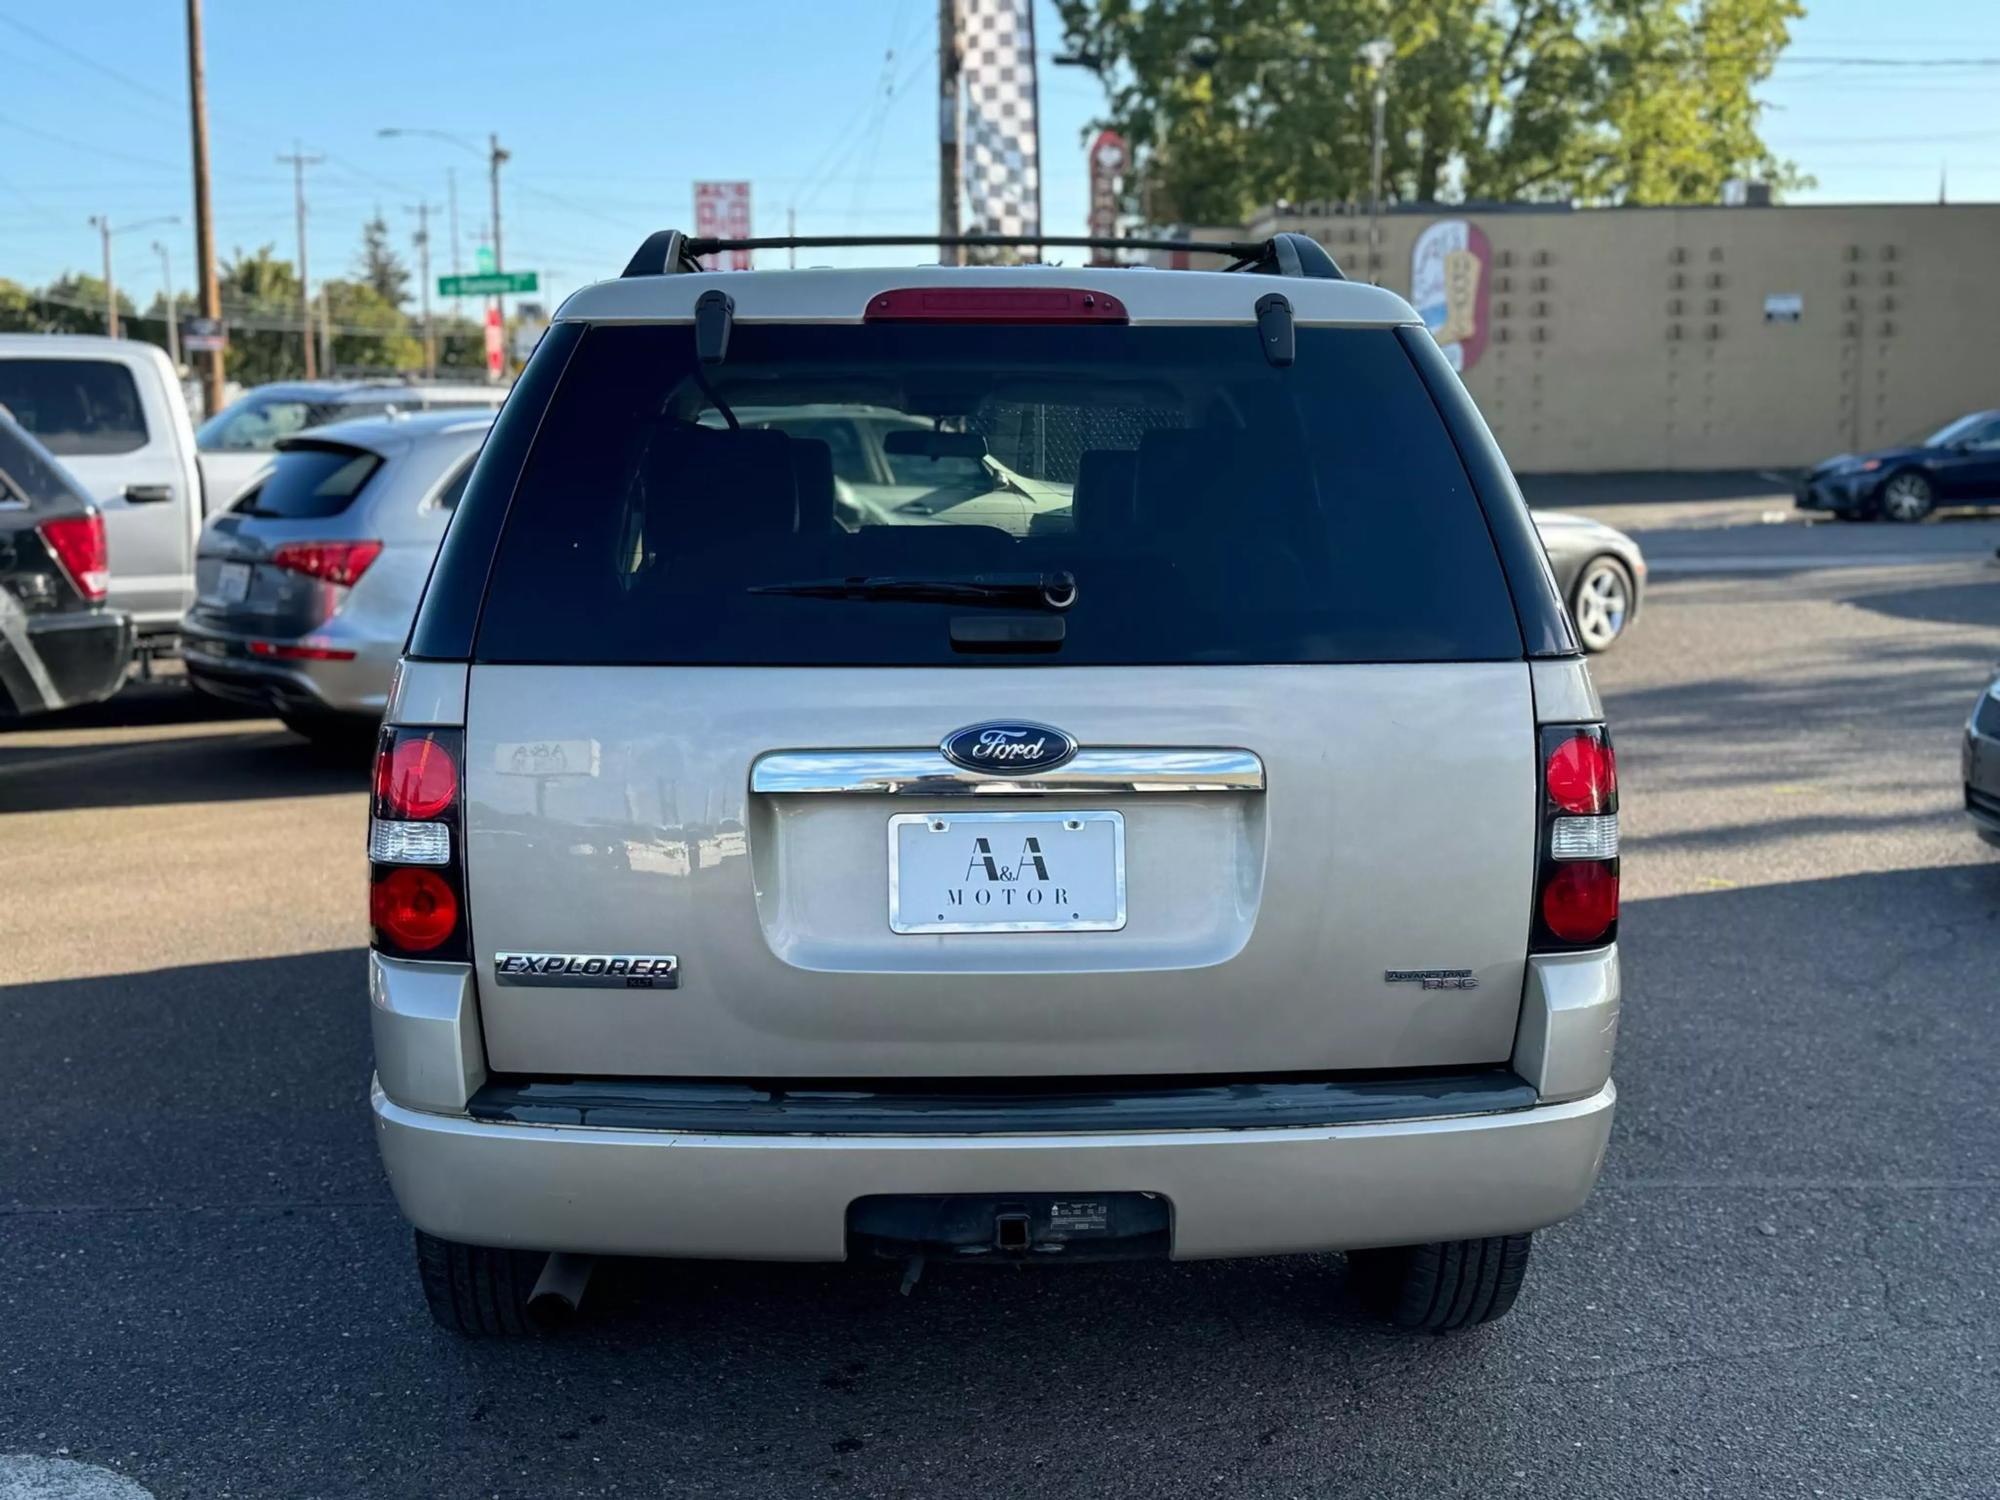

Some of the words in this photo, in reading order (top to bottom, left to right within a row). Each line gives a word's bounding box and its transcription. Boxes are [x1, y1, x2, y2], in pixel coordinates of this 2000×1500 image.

[972, 729, 1046, 760] Ford
[965, 837, 1050, 882] A&A
[947, 888, 1069, 906] MOTOR
[499, 955, 673, 977] EXPLORER
[628, 978, 652, 987] XLT
